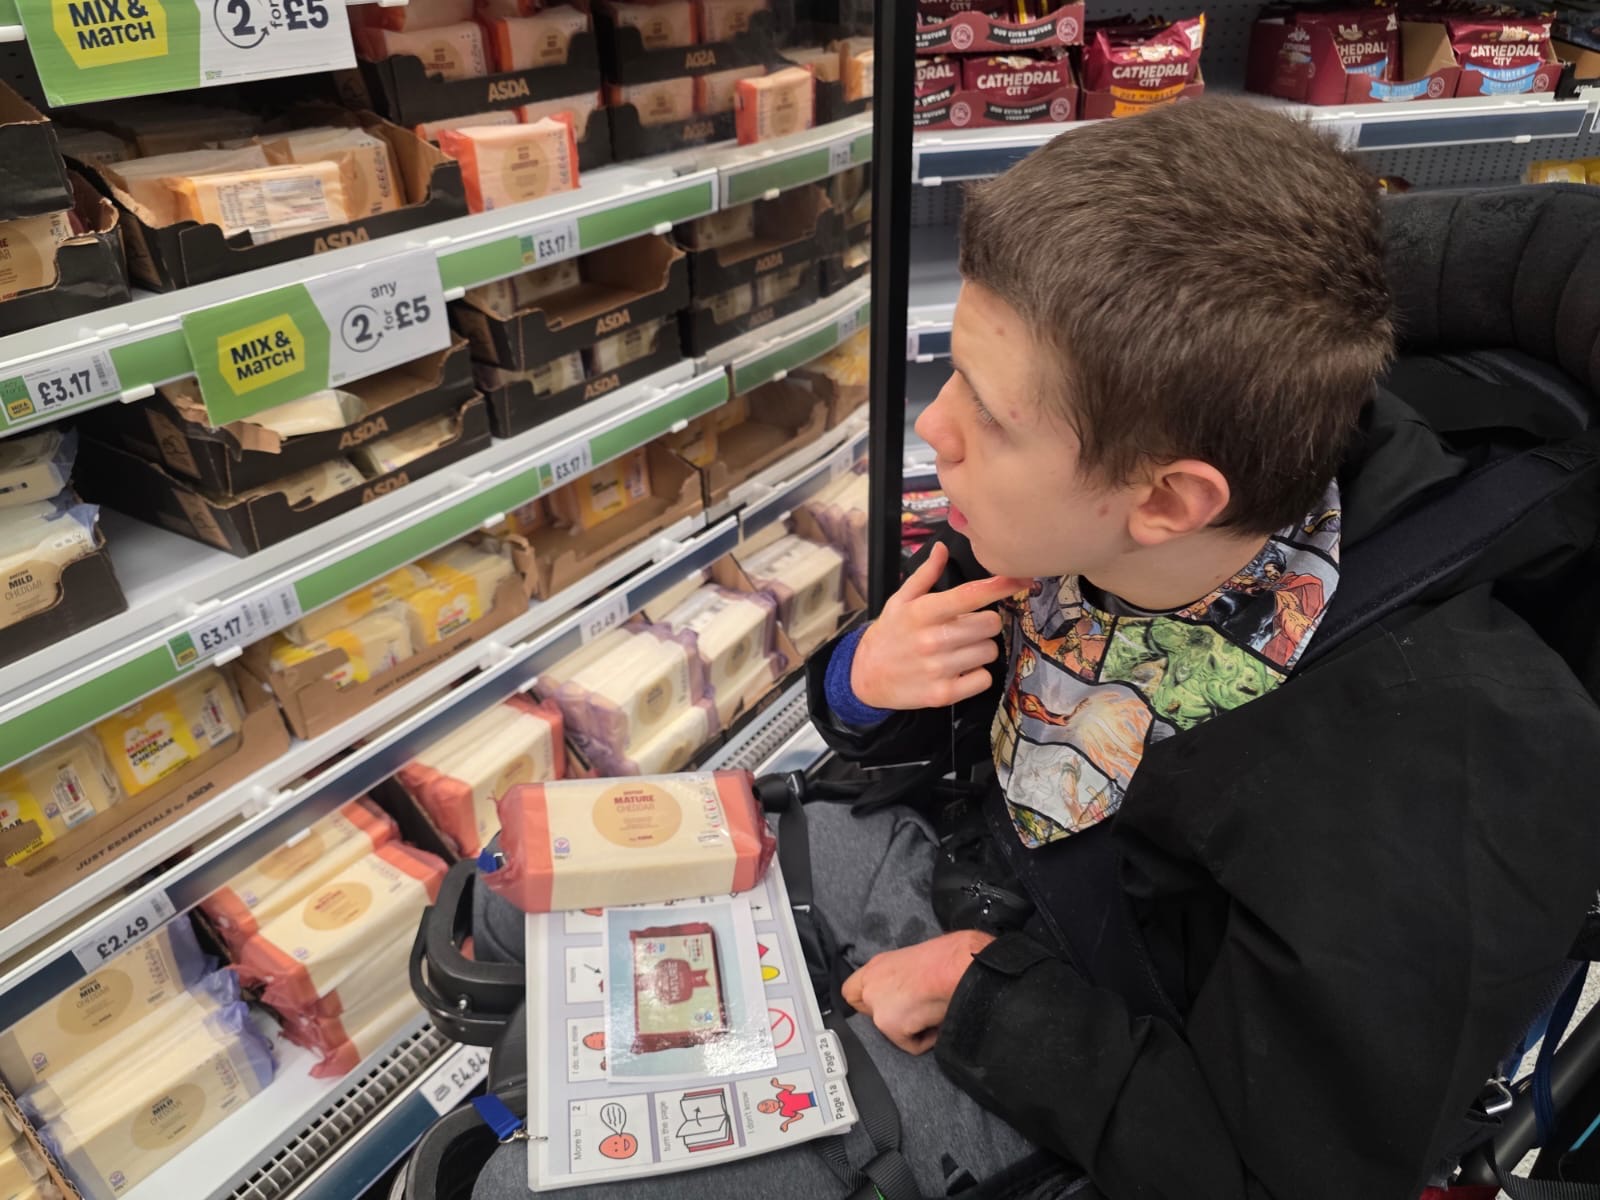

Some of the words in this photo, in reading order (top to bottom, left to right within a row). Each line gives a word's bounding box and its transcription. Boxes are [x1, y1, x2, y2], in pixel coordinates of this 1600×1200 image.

[68, 0, 125, 27] MIX
[227, 0, 256, 36] 2
[283, 0, 329, 31] £5
[1343, 56, 1362, 64] CITY
[1471, 44, 1541, 57] CATHEDRAL
[1493, 57, 1512, 66] CITY
[977, 70, 1061, 89] CATHEDRAL
[1112, 63, 1189, 79] CATHEDRAL
[1139, 78, 1161, 87] CITY
[488, 77, 530, 102] ASDA
[1006, 86, 1029, 96] CITY
[313, 227, 370, 254] ASDA
[539, 235, 565, 258] £3.17
[370, 281, 397, 299] any
[351, 314, 373, 344] 2
[383, 309, 395, 331] for
[395, 295, 431, 330] £5
[595, 308, 631, 336] ASDA
[229, 335, 272, 365] MIX
[275, 330, 292, 349] &
[38, 370, 91, 406] £3.17
[585, 373, 620, 400] ASDA
[338, 416, 388, 449] ASDA
[362, 471, 409, 503] ASDA
[8, 575, 33, 590] MILD
[200, 616, 241, 650] £3.17
[613, 795, 655, 805] MATURE
[76, 849, 105, 871] JUST
[107, 808, 172, 852] ESSENTIALS
[97, 916, 148, 959] £2.49
[820, 1037, 829, 1049] 2a
[451, 1052, 486, 1089] £4.84
[824, 1051, 836, 1074] Page
[829, 1084, 837, 1095] 1a
[833, 1097, 846, 1120] Page
[574, 1129, 582, 1137] to
[662, 1122, 670, 1134] the
[574, 1139, 583, 1160] More
